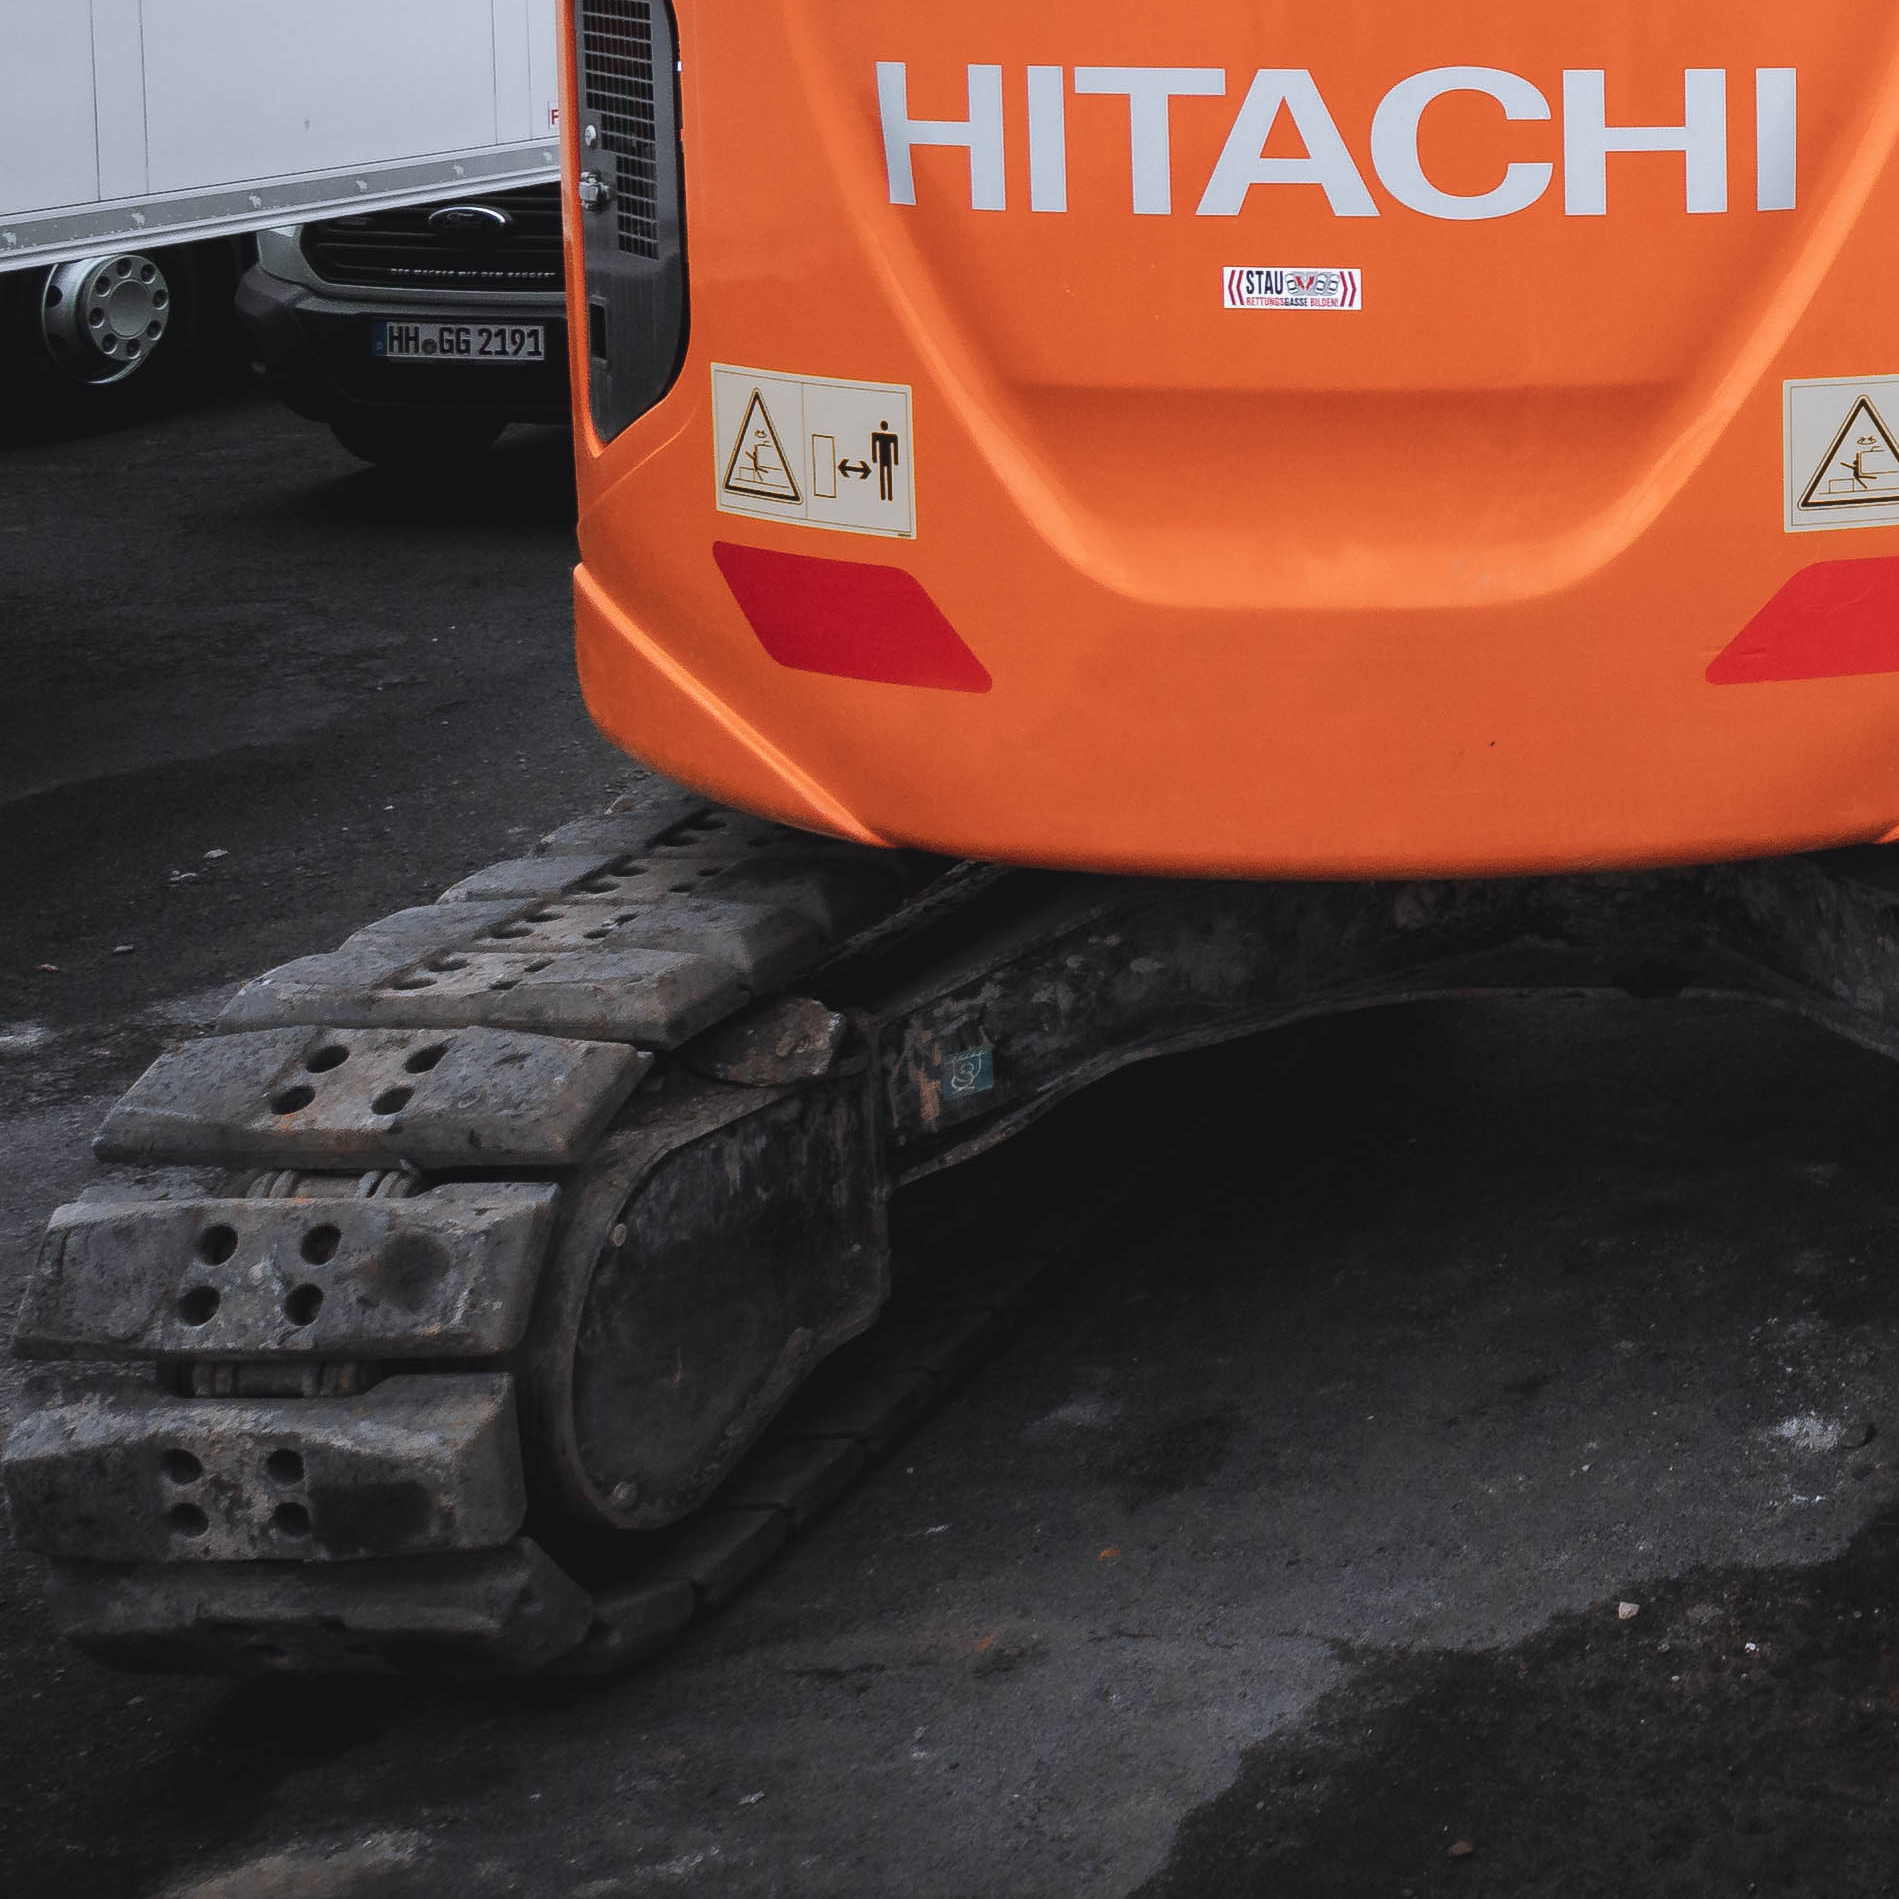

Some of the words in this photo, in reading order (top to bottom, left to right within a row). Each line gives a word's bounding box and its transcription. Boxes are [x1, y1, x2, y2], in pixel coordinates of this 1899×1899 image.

[875, 60, 1797, 222] HITACHI
[1246, 269, 1284, 295] STAU
[388, 325, 420, 354] HH
[438, 326, 472, 355] GG
[477, 327, 543, 357] 2191
